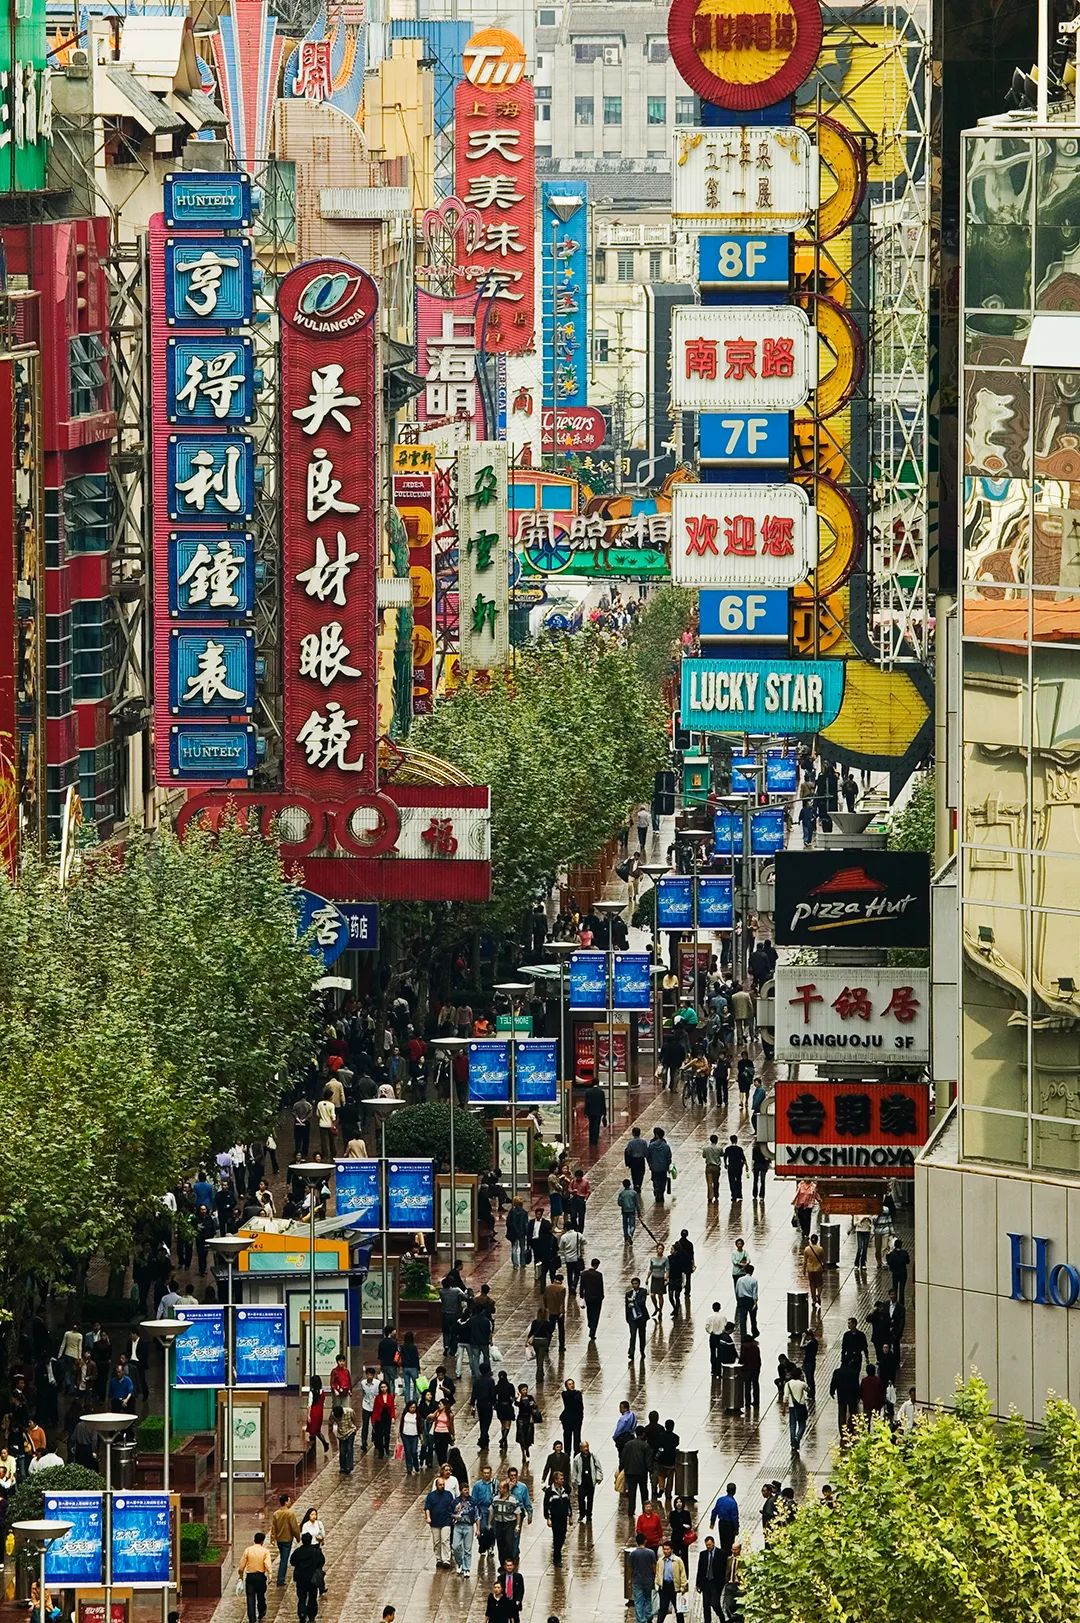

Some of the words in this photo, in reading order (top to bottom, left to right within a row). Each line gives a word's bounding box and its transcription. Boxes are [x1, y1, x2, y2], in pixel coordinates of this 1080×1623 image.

[465, 99, 521, 119] 上海
[176, 194, 237, 207] HUNTELY
[717, 240, 768, 278] 8F
[292, 309, 367, 333] WULIANGCAI
[684, 336, 796, 381] 南京路
[721, 418, 769, 455] 7F
[685, 515, 795, 557] 欢迎您
[718, 595, 768, 631] 6F
[690, 671, 759, 712] LUCKY
[765, 674, 824, 714] STAR
[182, 747, 242, 759] HUNTELY
[421, 817, 459, 855] 福
[865, 894, 917, 918] Hut
[789, 1033, 883, 1048] GANGUOJU
[894, 1036, 914, 1049] 3F
[786, 1145, 915, 1166] YOSHINOYA
